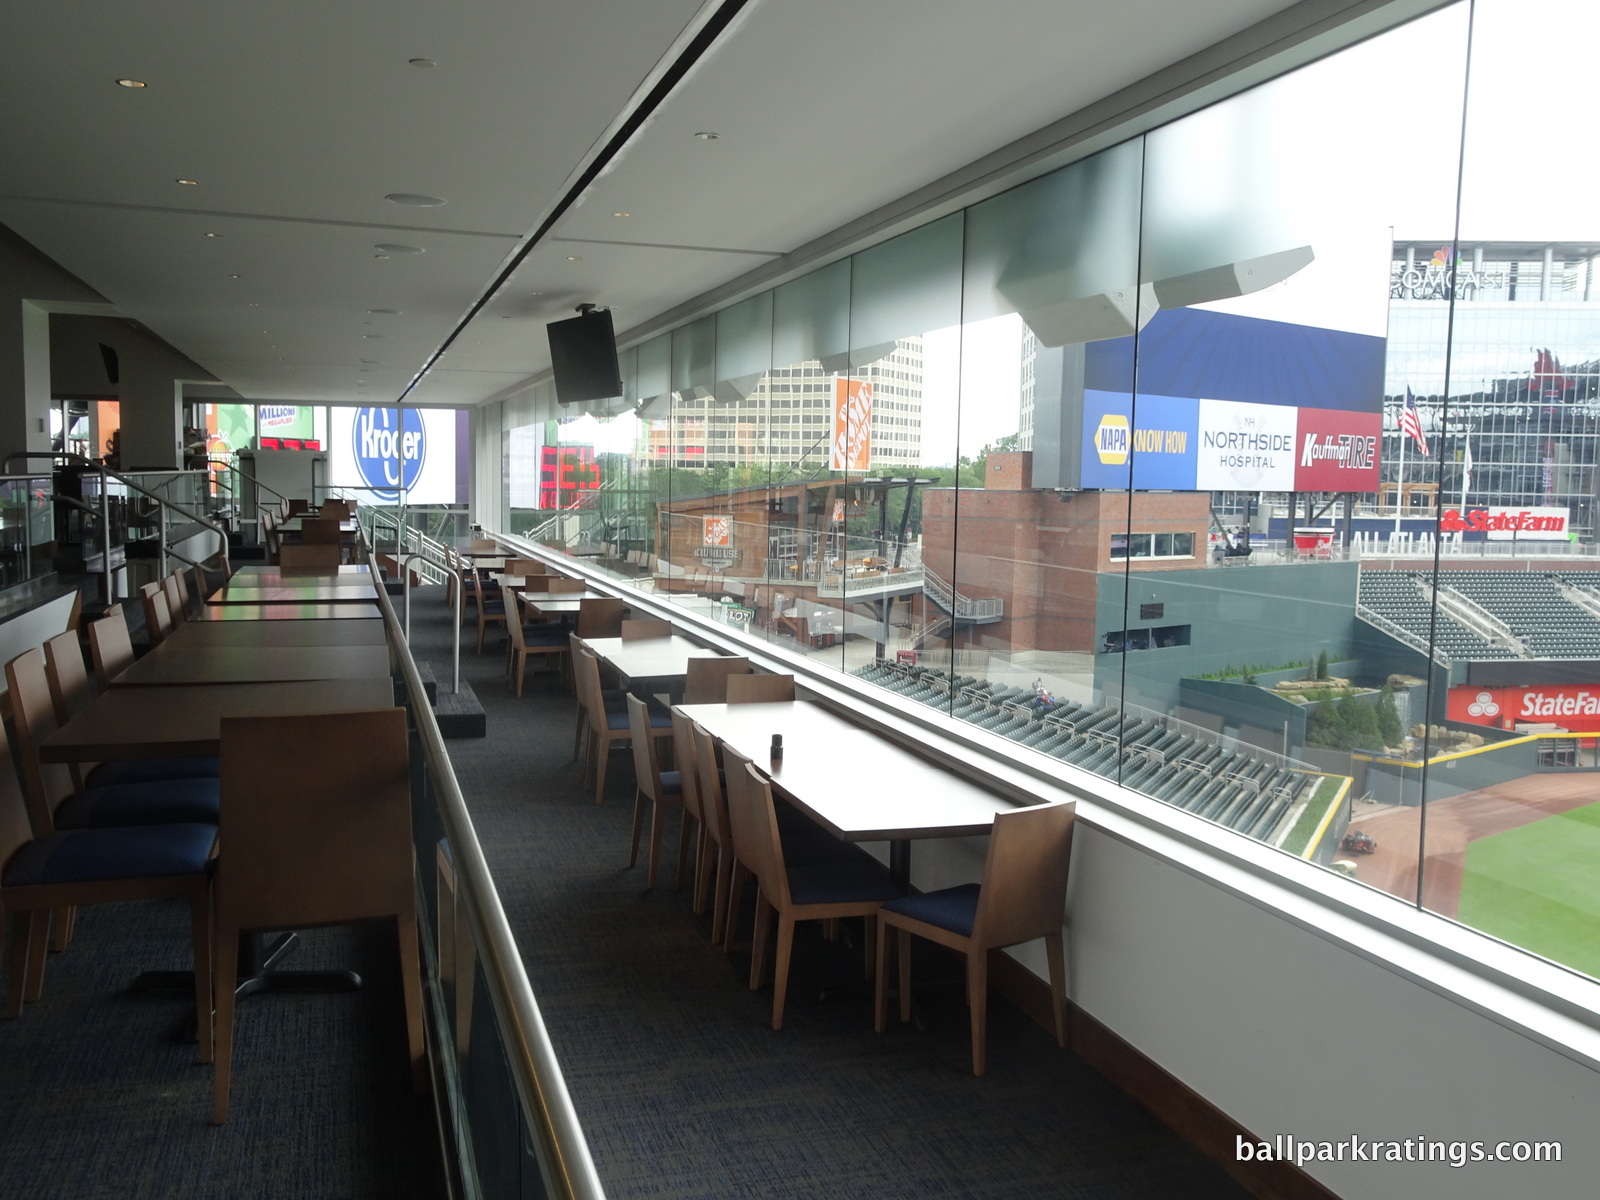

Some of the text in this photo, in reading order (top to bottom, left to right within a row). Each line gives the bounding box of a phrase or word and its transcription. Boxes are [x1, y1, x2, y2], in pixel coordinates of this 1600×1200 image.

[362, 408, 421, 485] Kroger
[1101, 428, 1187, 454] NAPA KNOW HOW
[1203, 430, 1292, 451] NORTHSIDE
[1301, 433, 1376, 469] Kauffman TIRE
[1220, 455, 1276, 469] HOSPITAL
